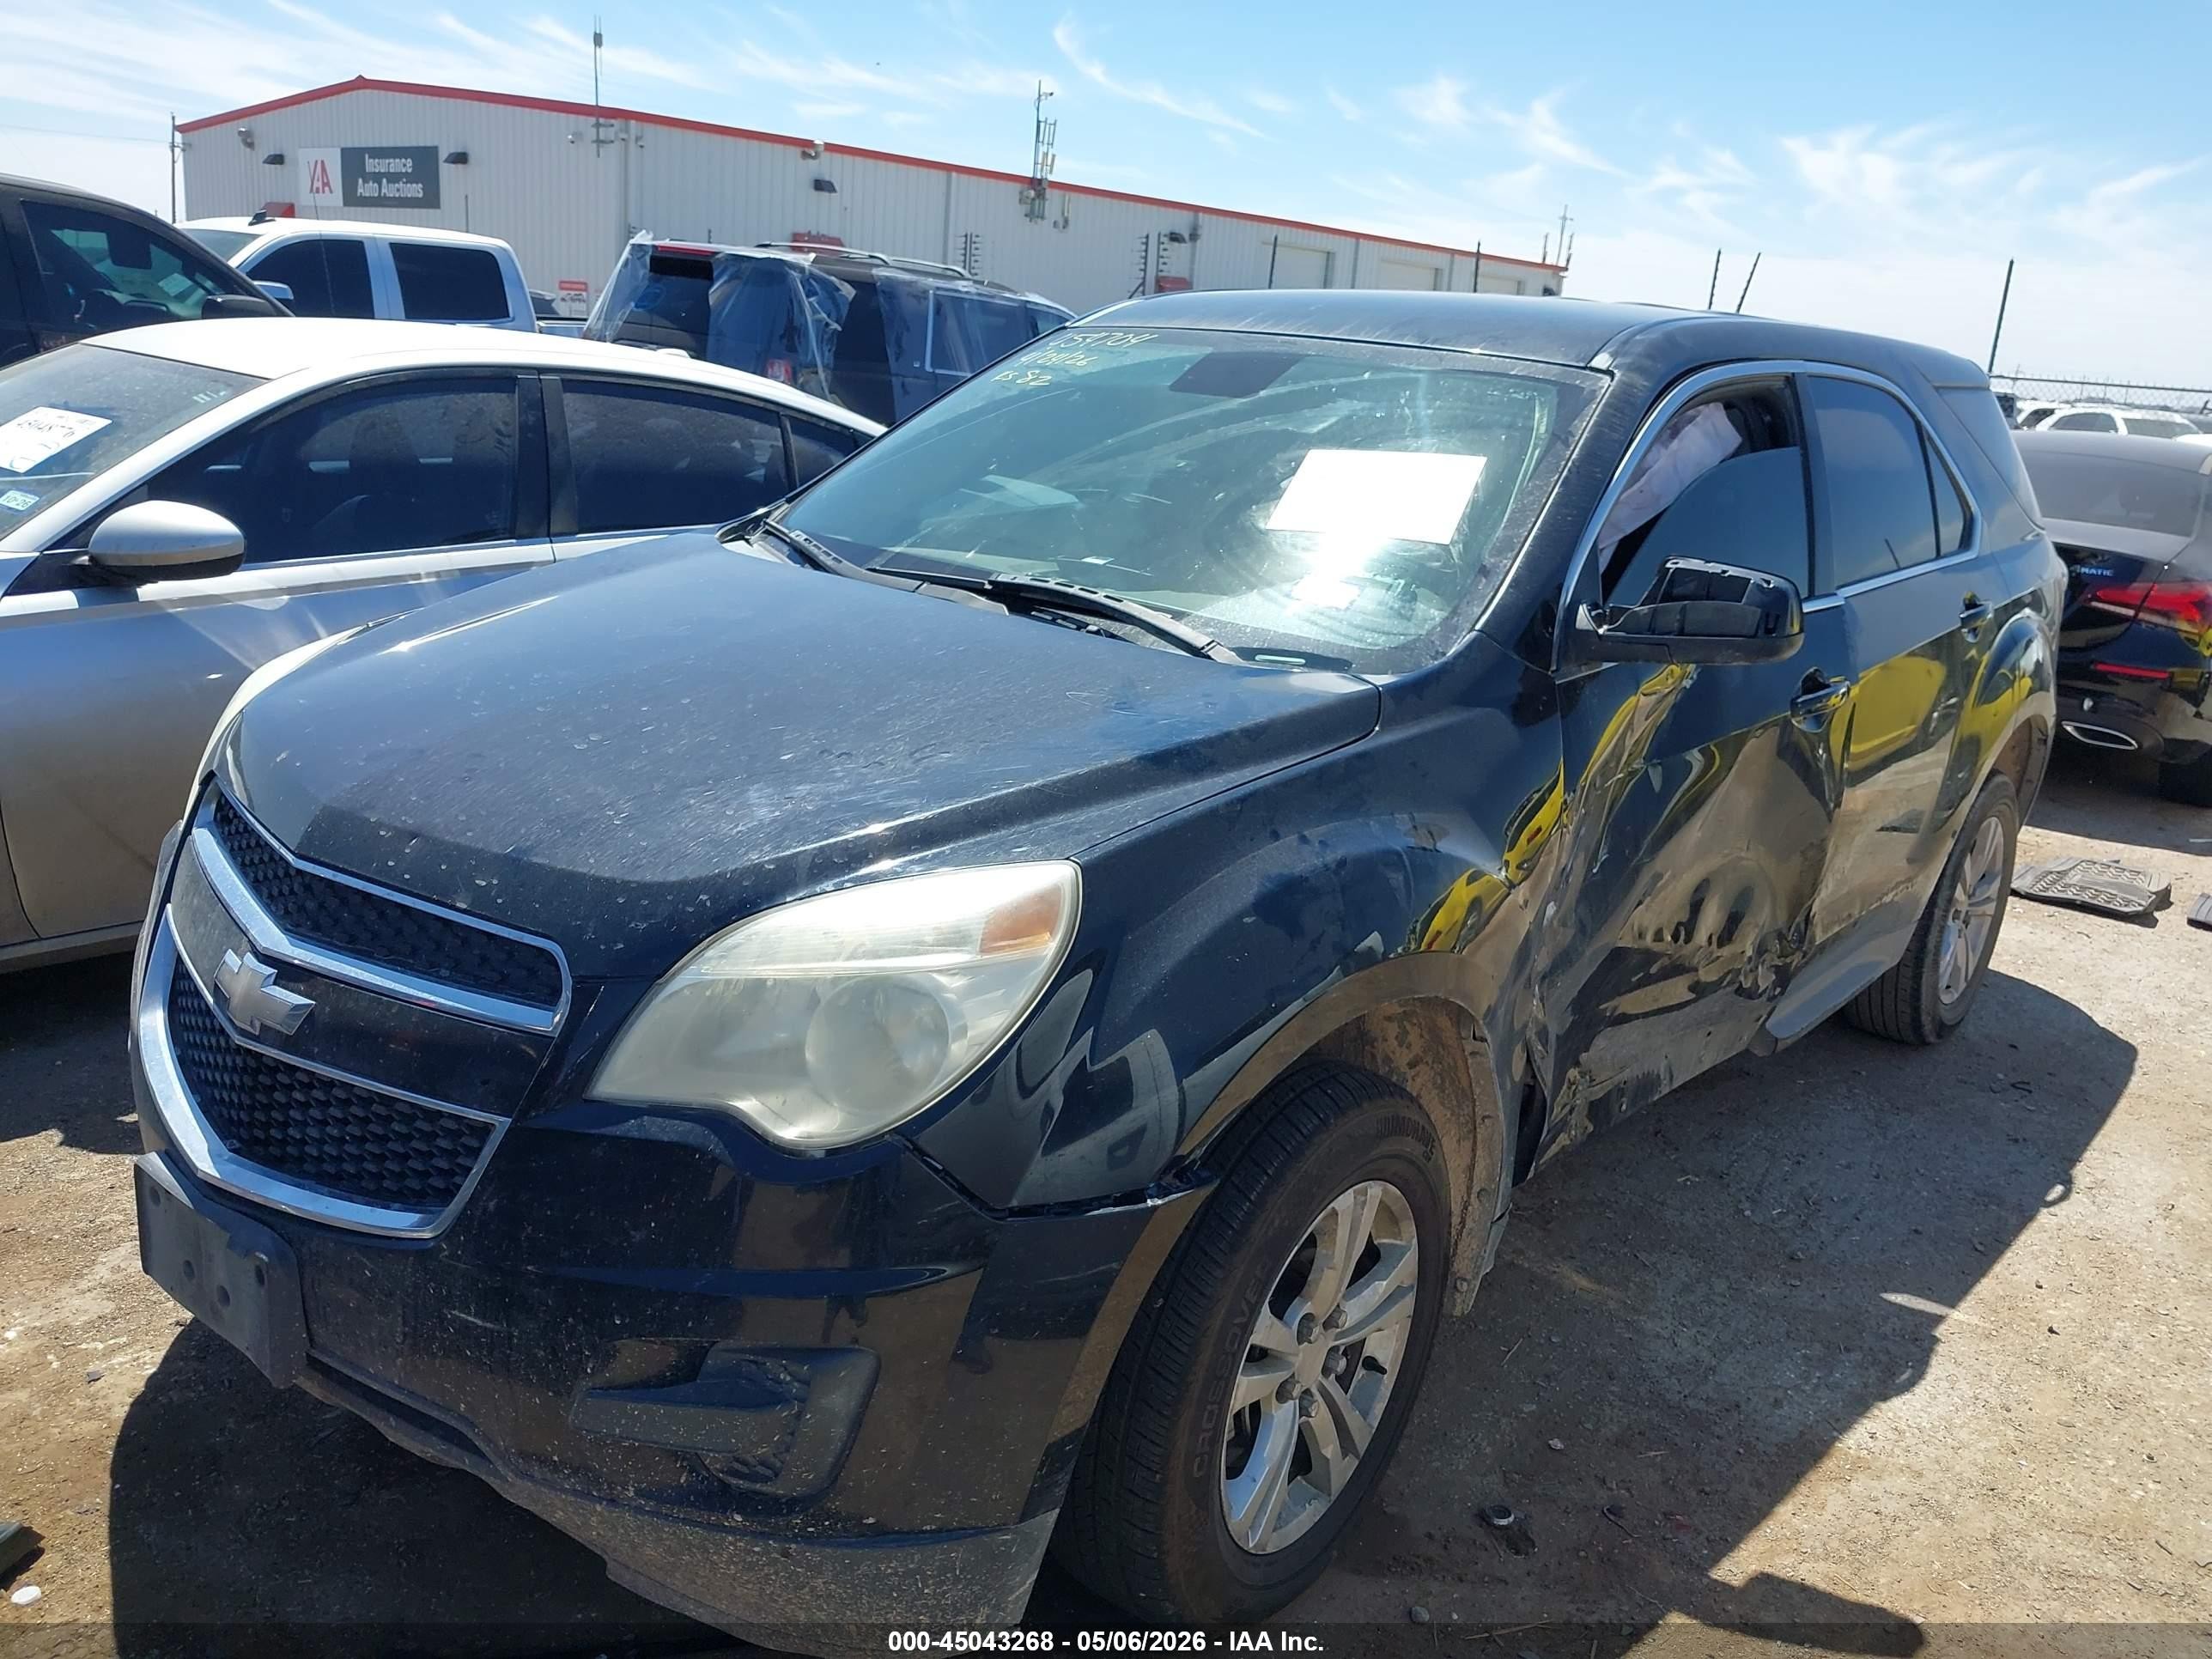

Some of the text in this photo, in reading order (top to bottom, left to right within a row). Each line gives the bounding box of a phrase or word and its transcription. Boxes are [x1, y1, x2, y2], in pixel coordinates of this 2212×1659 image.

[365, 153, 413, 173] Insurance
[357, 178, 424, 198] Auto Auctions
